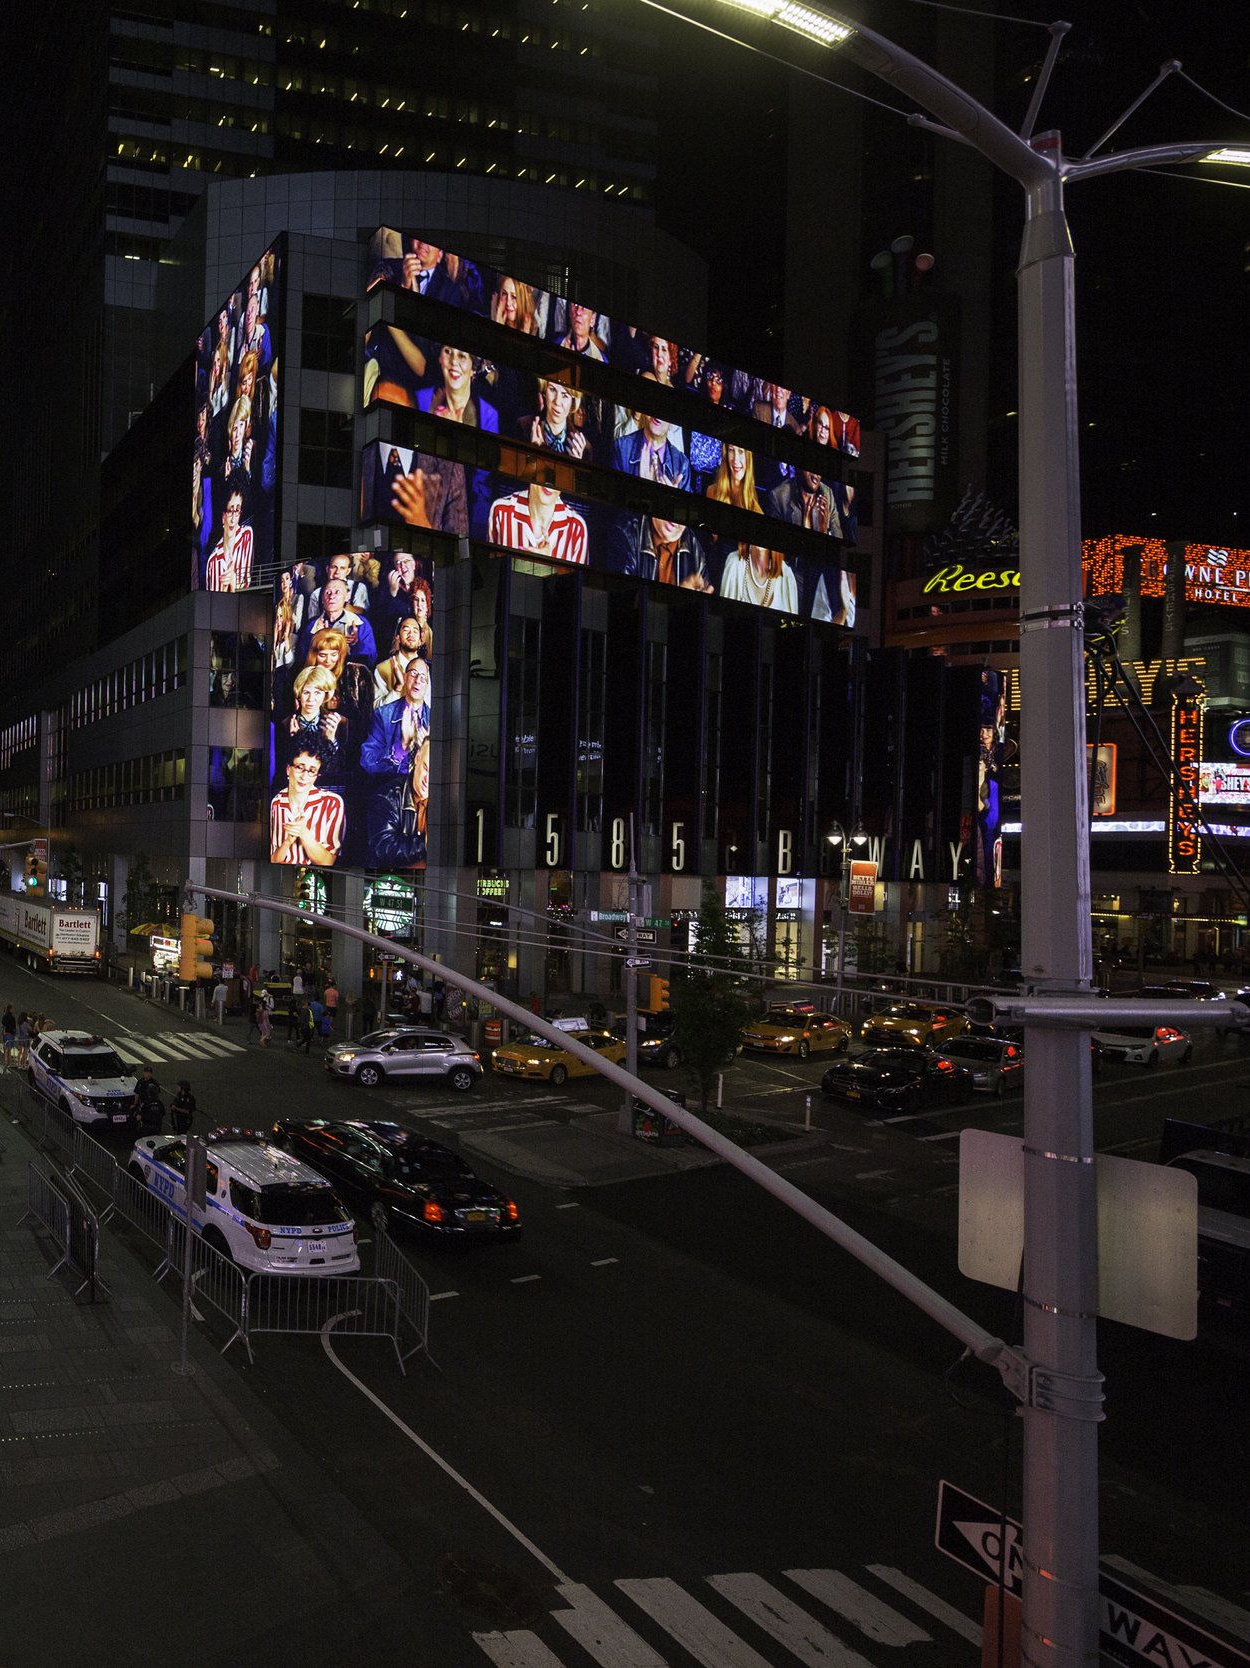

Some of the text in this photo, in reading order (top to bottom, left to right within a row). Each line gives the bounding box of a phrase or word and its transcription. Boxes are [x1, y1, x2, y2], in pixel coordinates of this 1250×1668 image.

[941, 358, 950, 433] CHOCOLATE
[1194, 589, 1238, 602] HOTEL
[380, 898, 385, 906] W
[388, 899, 394, 907] 47
[24, 910, 46, 935] Bartlett
[59, 919, 91, 928] Bartlett
[599, 912, 627, 923] Broadway
[154, 1171, 174, 1199] NYPD
[327, 1223, 350, 1233] POLICE
